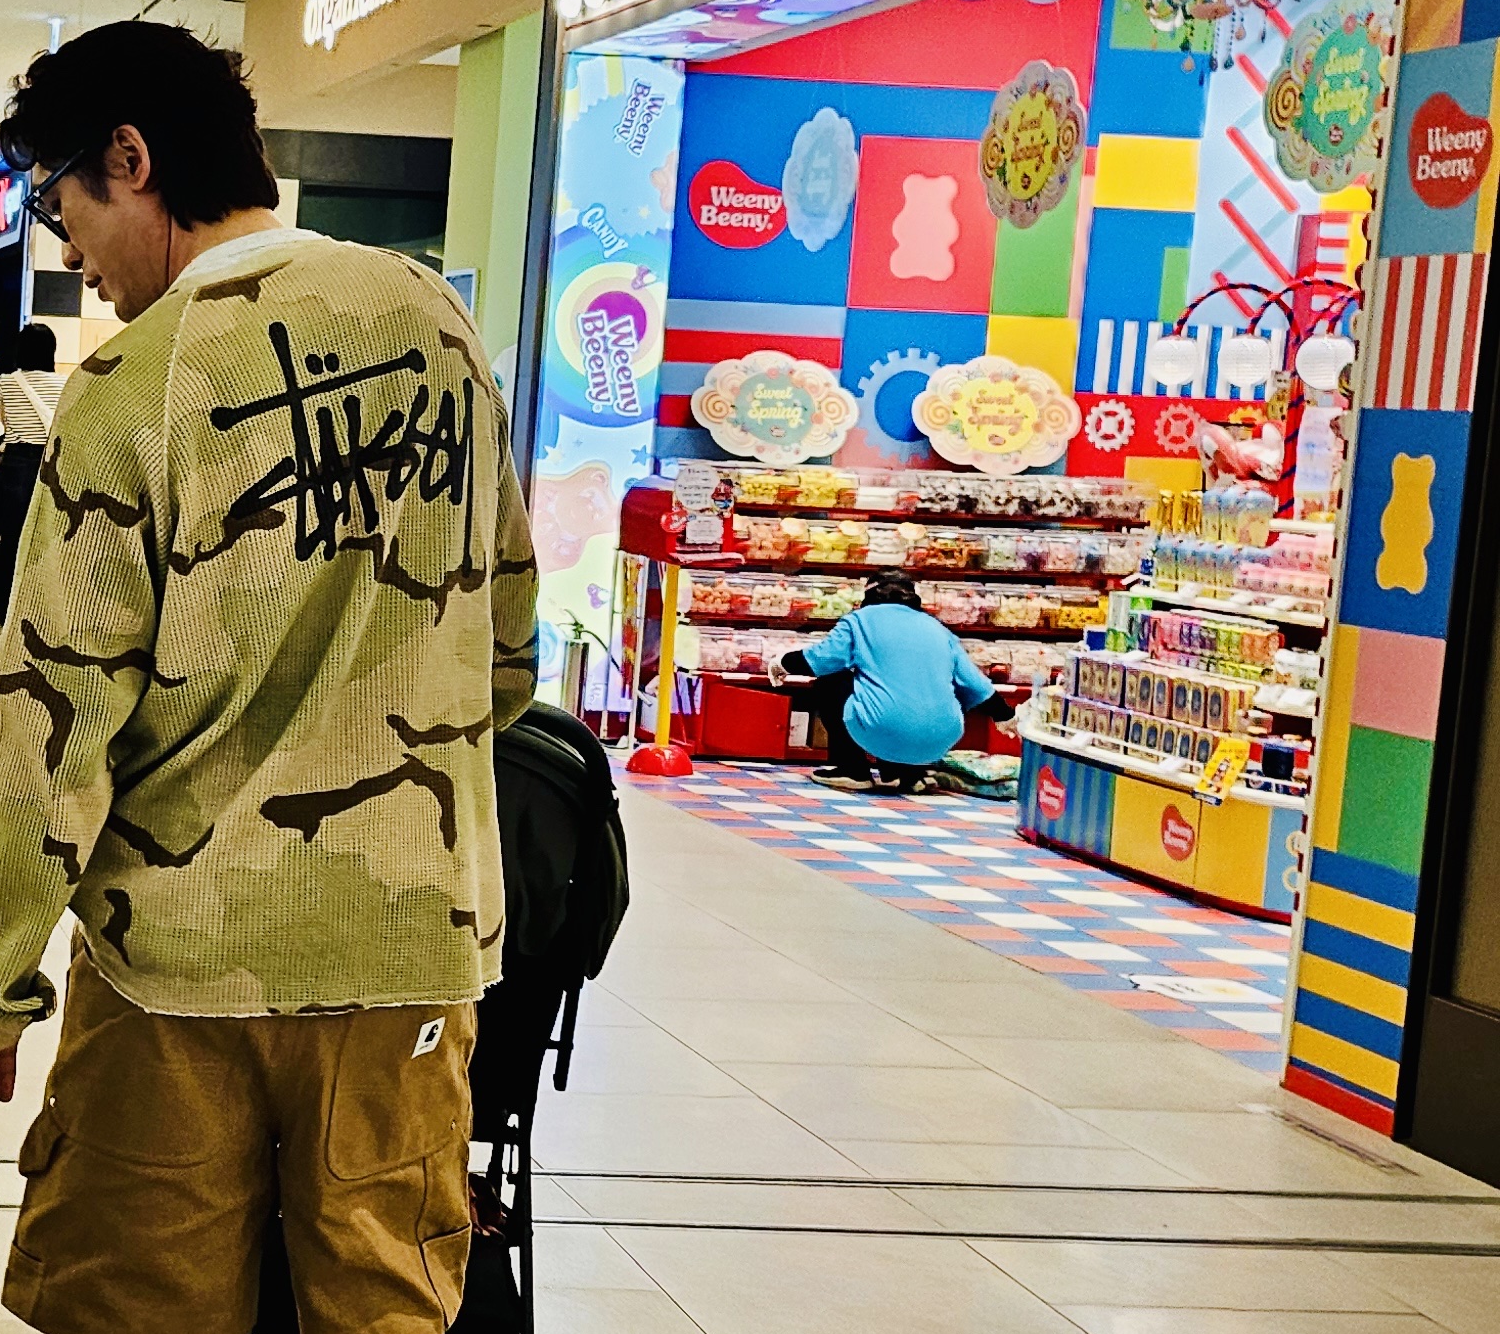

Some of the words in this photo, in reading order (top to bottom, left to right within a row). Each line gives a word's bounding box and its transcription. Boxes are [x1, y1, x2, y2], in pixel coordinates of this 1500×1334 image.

[1426, 126, 1488, 154] Weeny
[710, 185, 783, 214] Weeny
[581, 206, 629, 259] CANDY
[608, 317, 639, 414] Weeny
